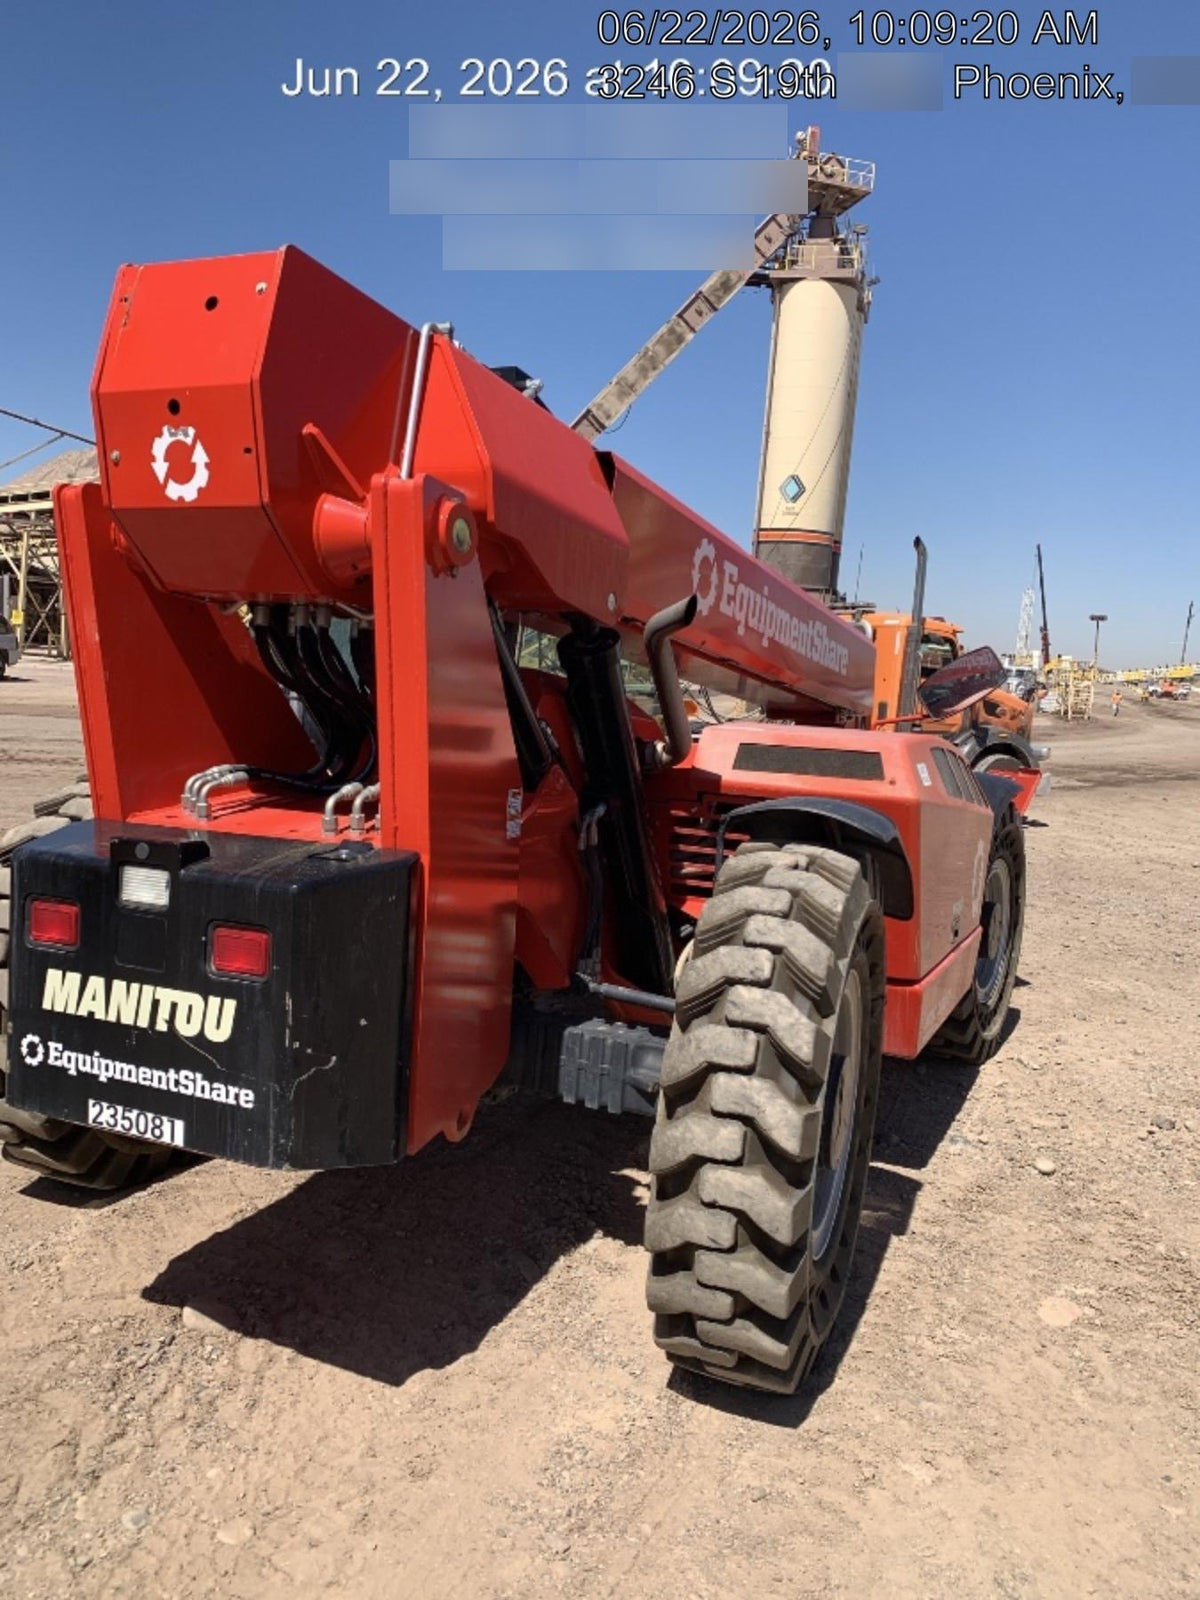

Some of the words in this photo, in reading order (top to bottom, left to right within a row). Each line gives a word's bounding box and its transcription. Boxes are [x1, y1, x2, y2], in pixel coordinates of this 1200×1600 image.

[720, 560, 848, 675] EquipmentShare
[41, 968, 237, 1043] MANITOU
[47, 1041, 255, 1109] EquipmentShare
[91, 1101, 178, 1143] 235081
